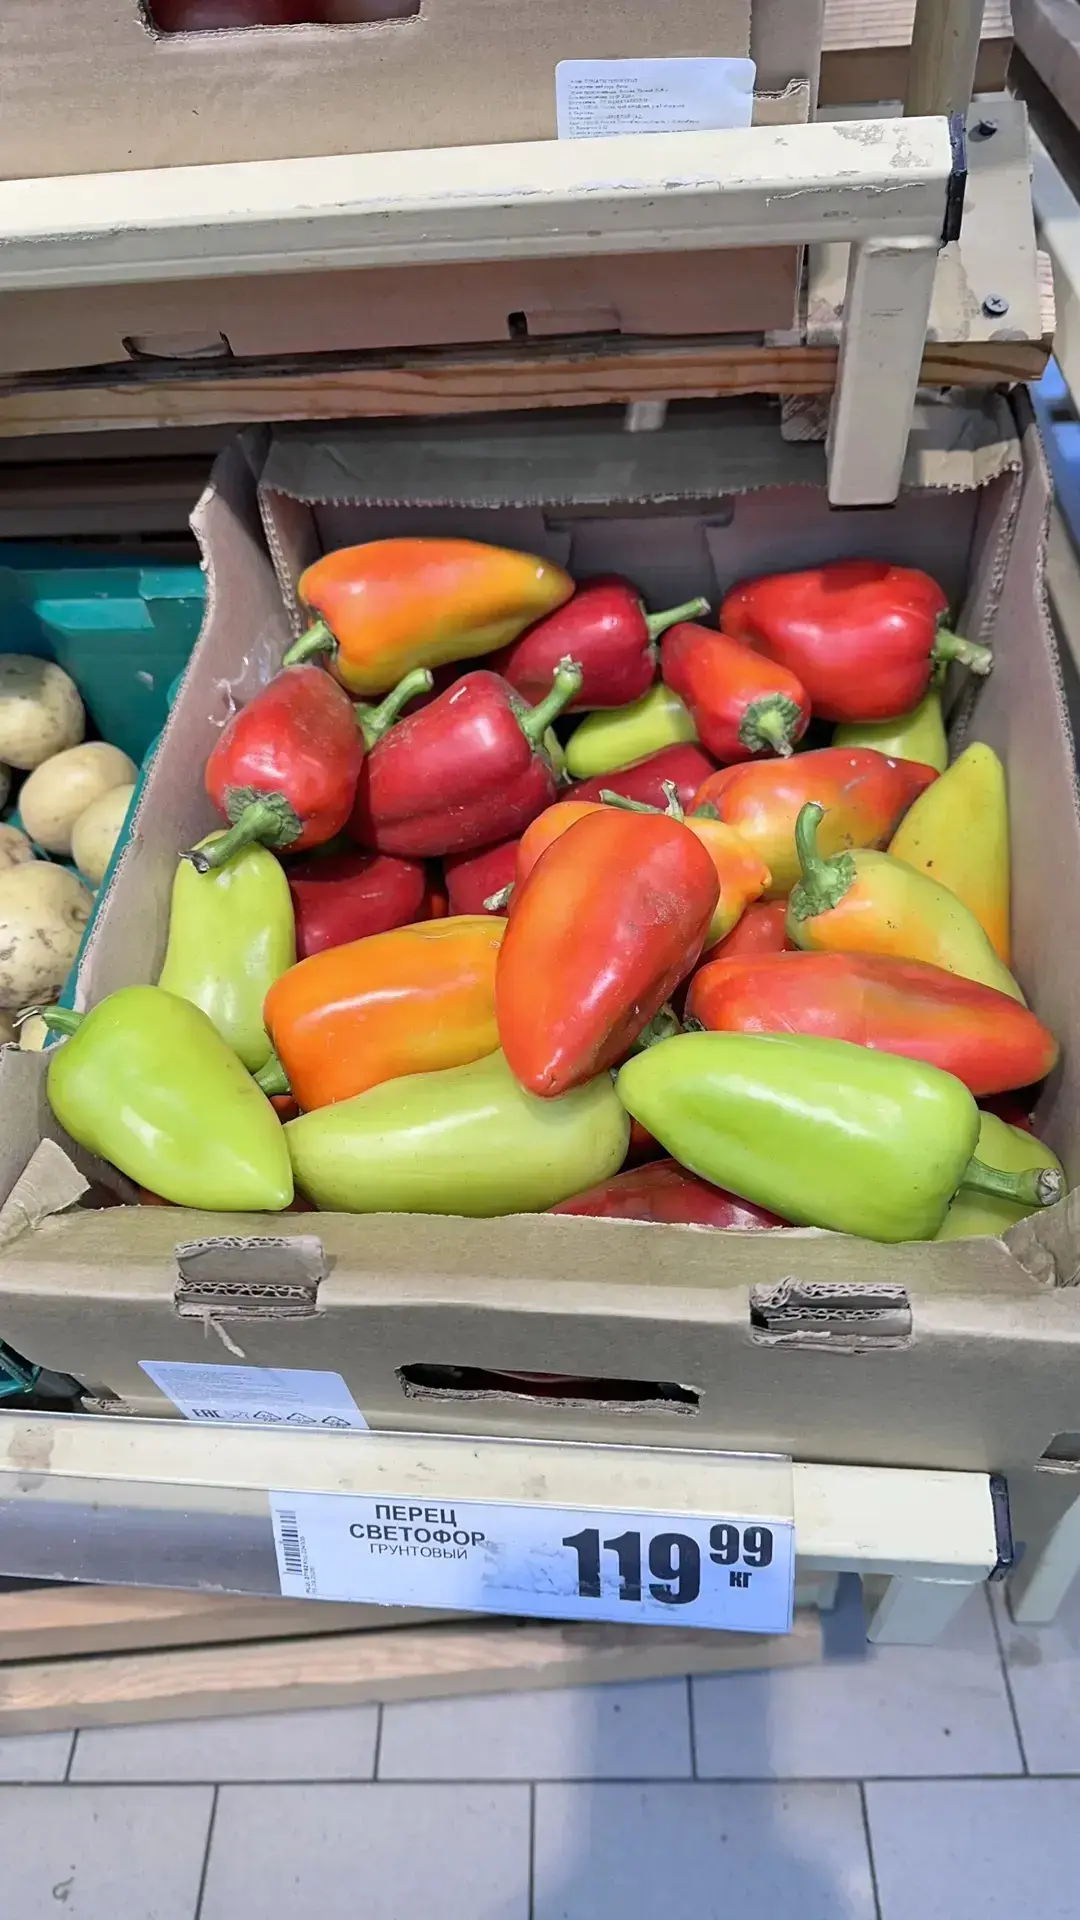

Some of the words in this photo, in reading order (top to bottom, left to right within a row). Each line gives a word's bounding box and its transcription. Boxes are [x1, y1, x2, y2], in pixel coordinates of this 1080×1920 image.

[375, 1504, 457, 1527] ПЕРЕЦ
[350, 1523, 485, 1546] СВЕТОФОР
[369, 1542, 468, 1560] ГРУНТОВЫЙ
[562, 1528, 701, 1604] 119
[709, 1523, 773, 1567] 99
